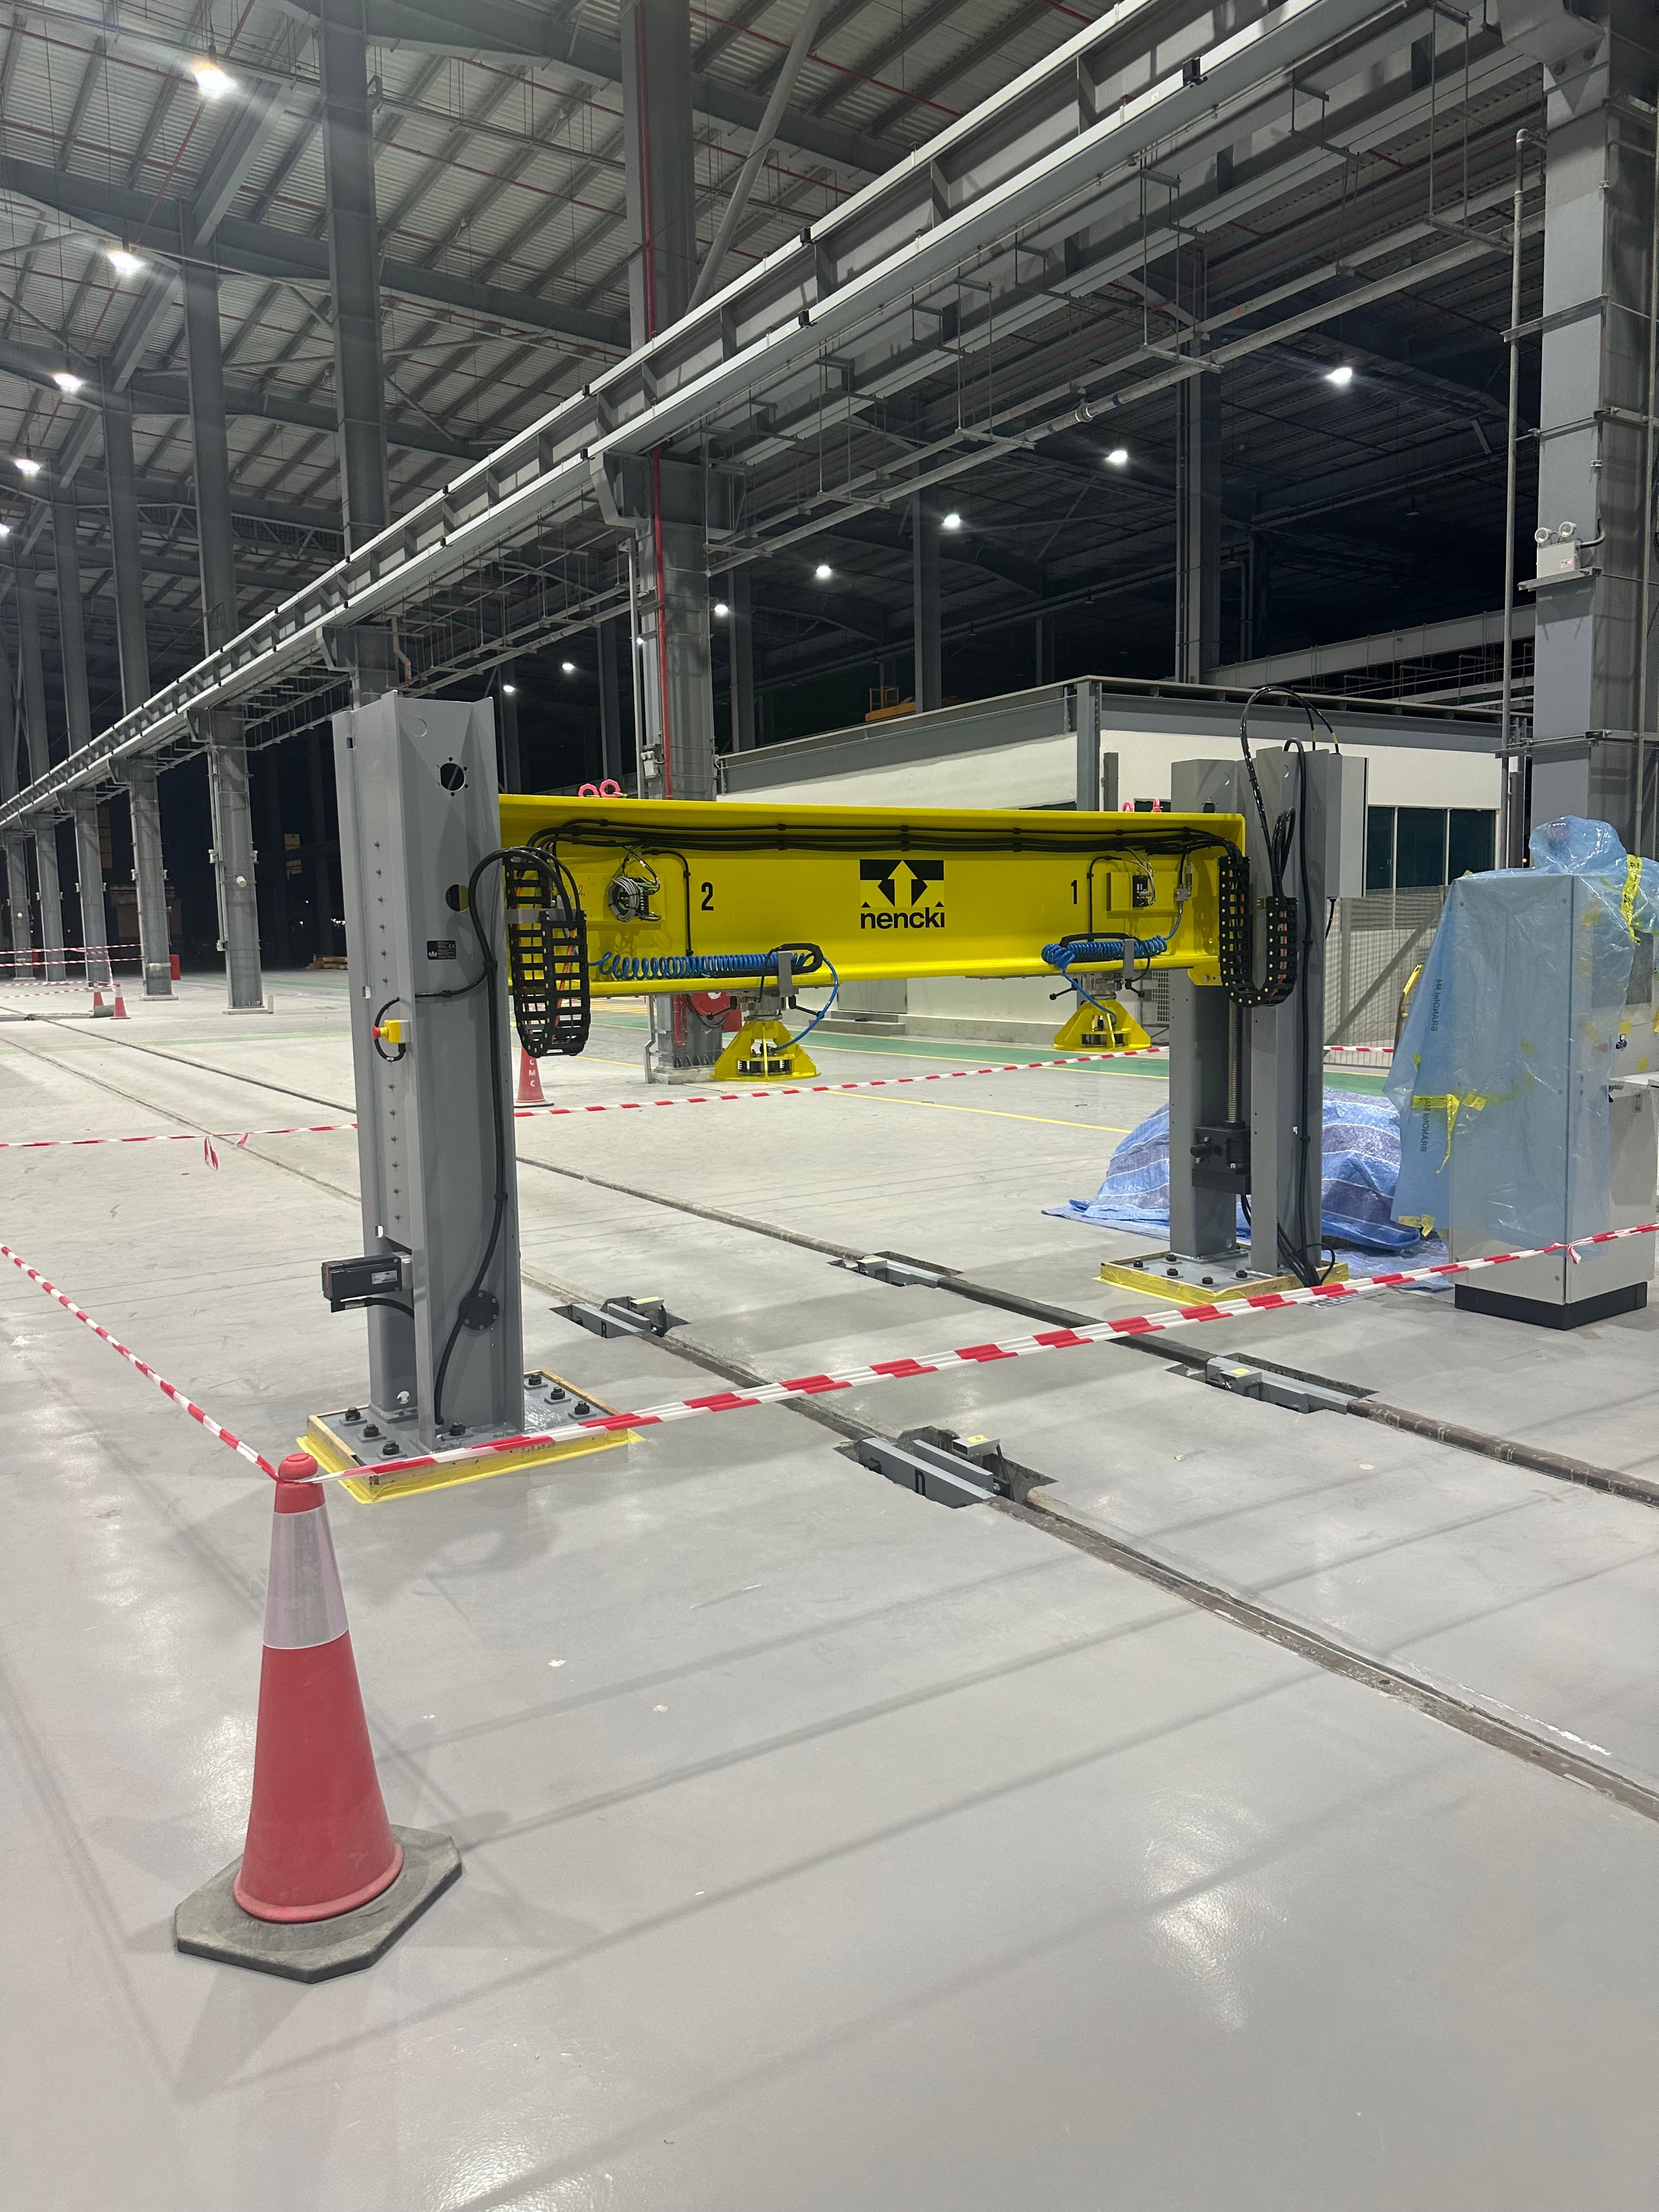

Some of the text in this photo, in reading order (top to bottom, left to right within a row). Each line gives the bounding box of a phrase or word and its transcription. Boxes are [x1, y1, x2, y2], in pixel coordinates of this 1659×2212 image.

[702, 882, 714, 910] 2
[1071, 880, 1077, 904] 1
[861, 907, 945, 929] nencki
